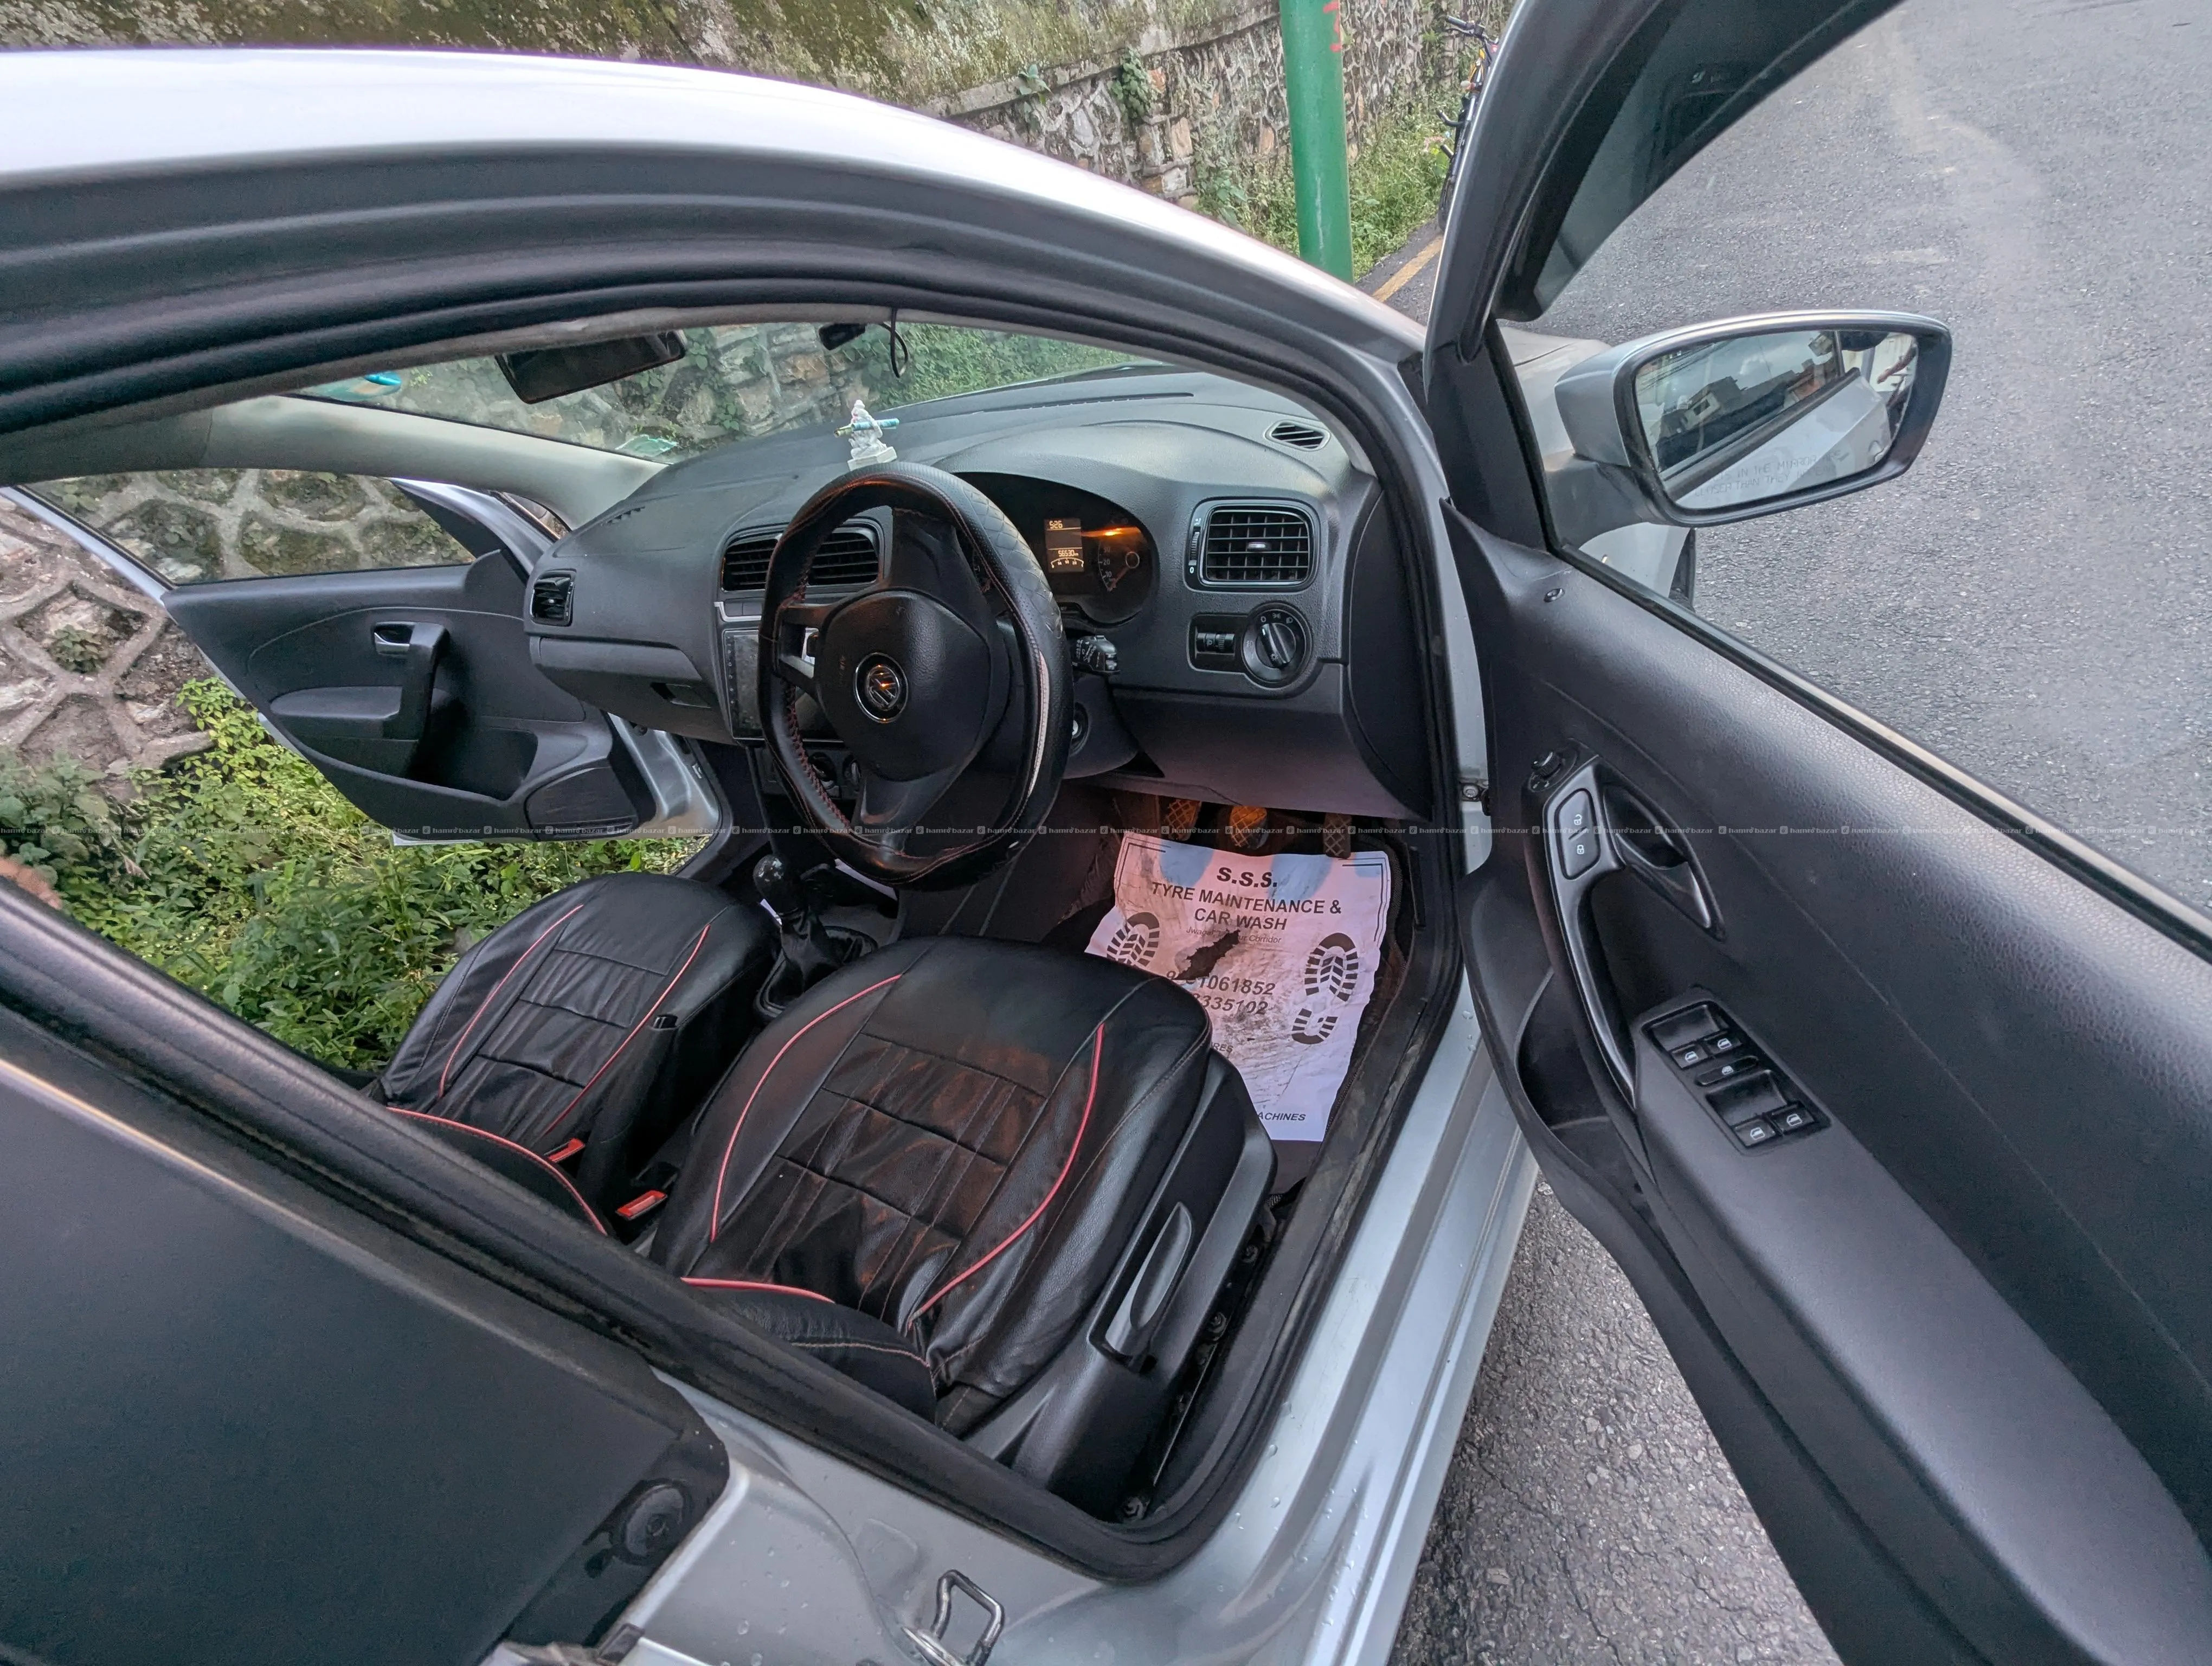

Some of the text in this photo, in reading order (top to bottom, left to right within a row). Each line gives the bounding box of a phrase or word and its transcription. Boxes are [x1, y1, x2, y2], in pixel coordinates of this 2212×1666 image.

[1217, 867, 1278, 888] S.S.S.
[1152, 881, 1342, 914] TYRE MAINTENANCE &
[1194, 907, 1287, 931] CAR WASH
[1166, 970, 1276, 995] 91061852
[1211, 1043, 1234, 1053] RES
[1257, 1111, 1307, 1121] ACHINES
